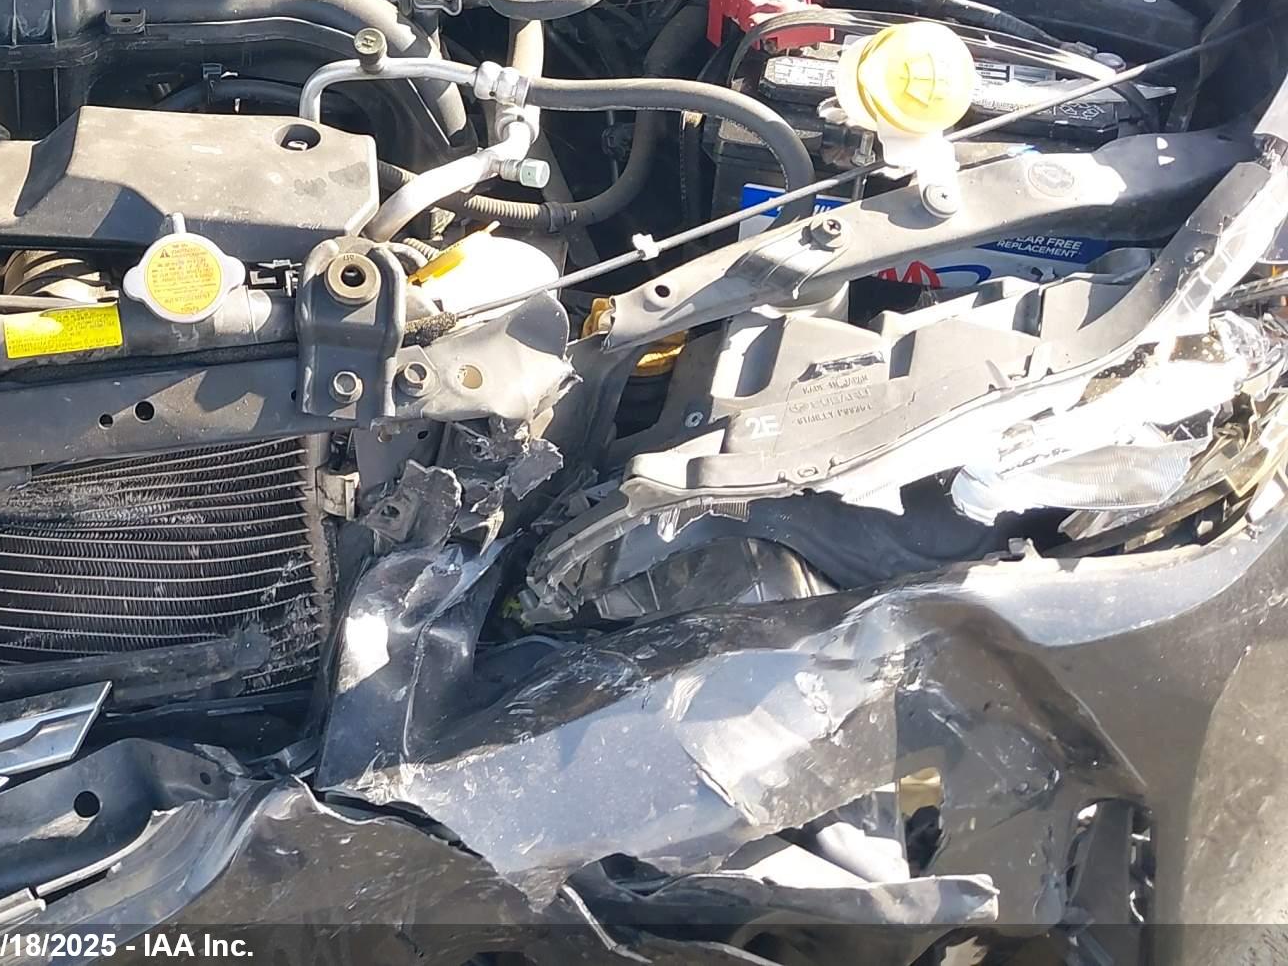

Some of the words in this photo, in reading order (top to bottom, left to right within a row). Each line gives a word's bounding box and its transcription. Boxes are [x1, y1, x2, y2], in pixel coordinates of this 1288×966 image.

[996, 240, 1078, 258] REPLACEMENT
[1046, 237, 1083, 250] FREE
[744, 415, 777, 439] 2E
